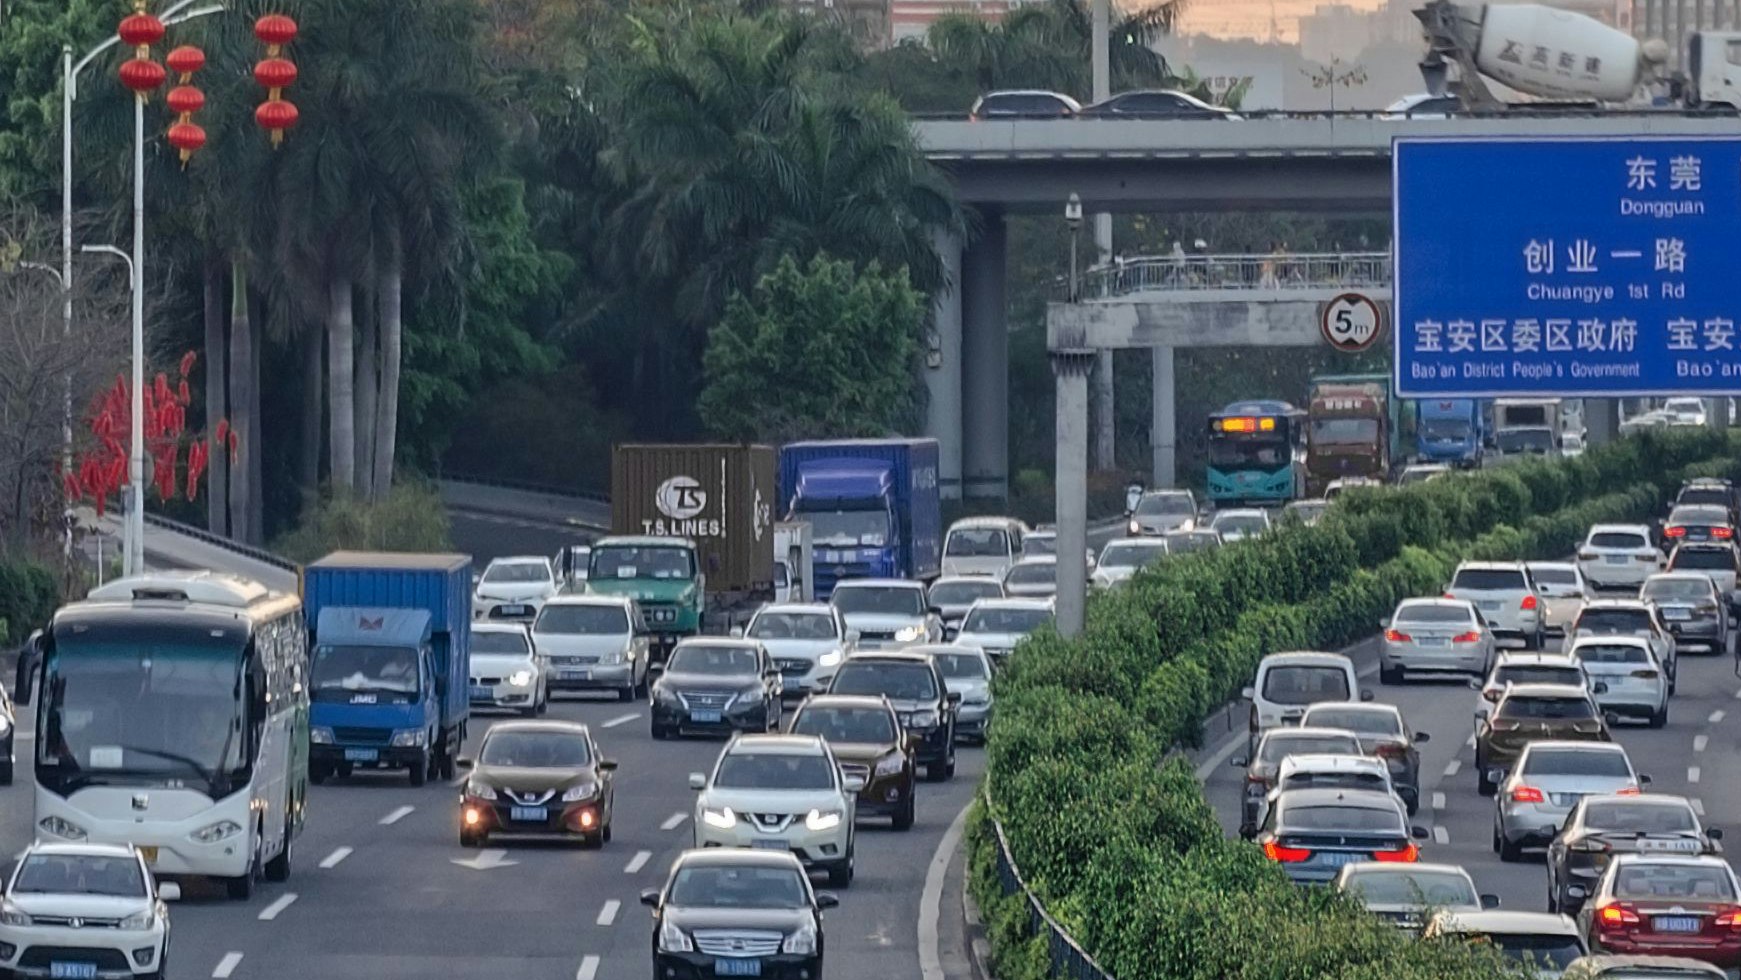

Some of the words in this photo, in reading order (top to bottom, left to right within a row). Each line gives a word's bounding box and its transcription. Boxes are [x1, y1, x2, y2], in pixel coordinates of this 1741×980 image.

[1626, 155, 1702, 191] 东莞
[1621, 199, 1704, 217] Dongguan
[1523, 237, 1687, 274] 创业一路
[1527, 283, 1614, 302] Chuangye
[1628, 283, 1649, 299] 1st
[1661, 282, 1685, 298] Rd
[1414, 317, 1638, 353] 宝安区委区政府
[1463, 362, 1505, 378] District
[1512, 362, 1563, 380] People's
[1570, 362, 1640, 378] Government
[641, 519, 669, 537] T.S.
[670, 519, 720, 537] LINES
